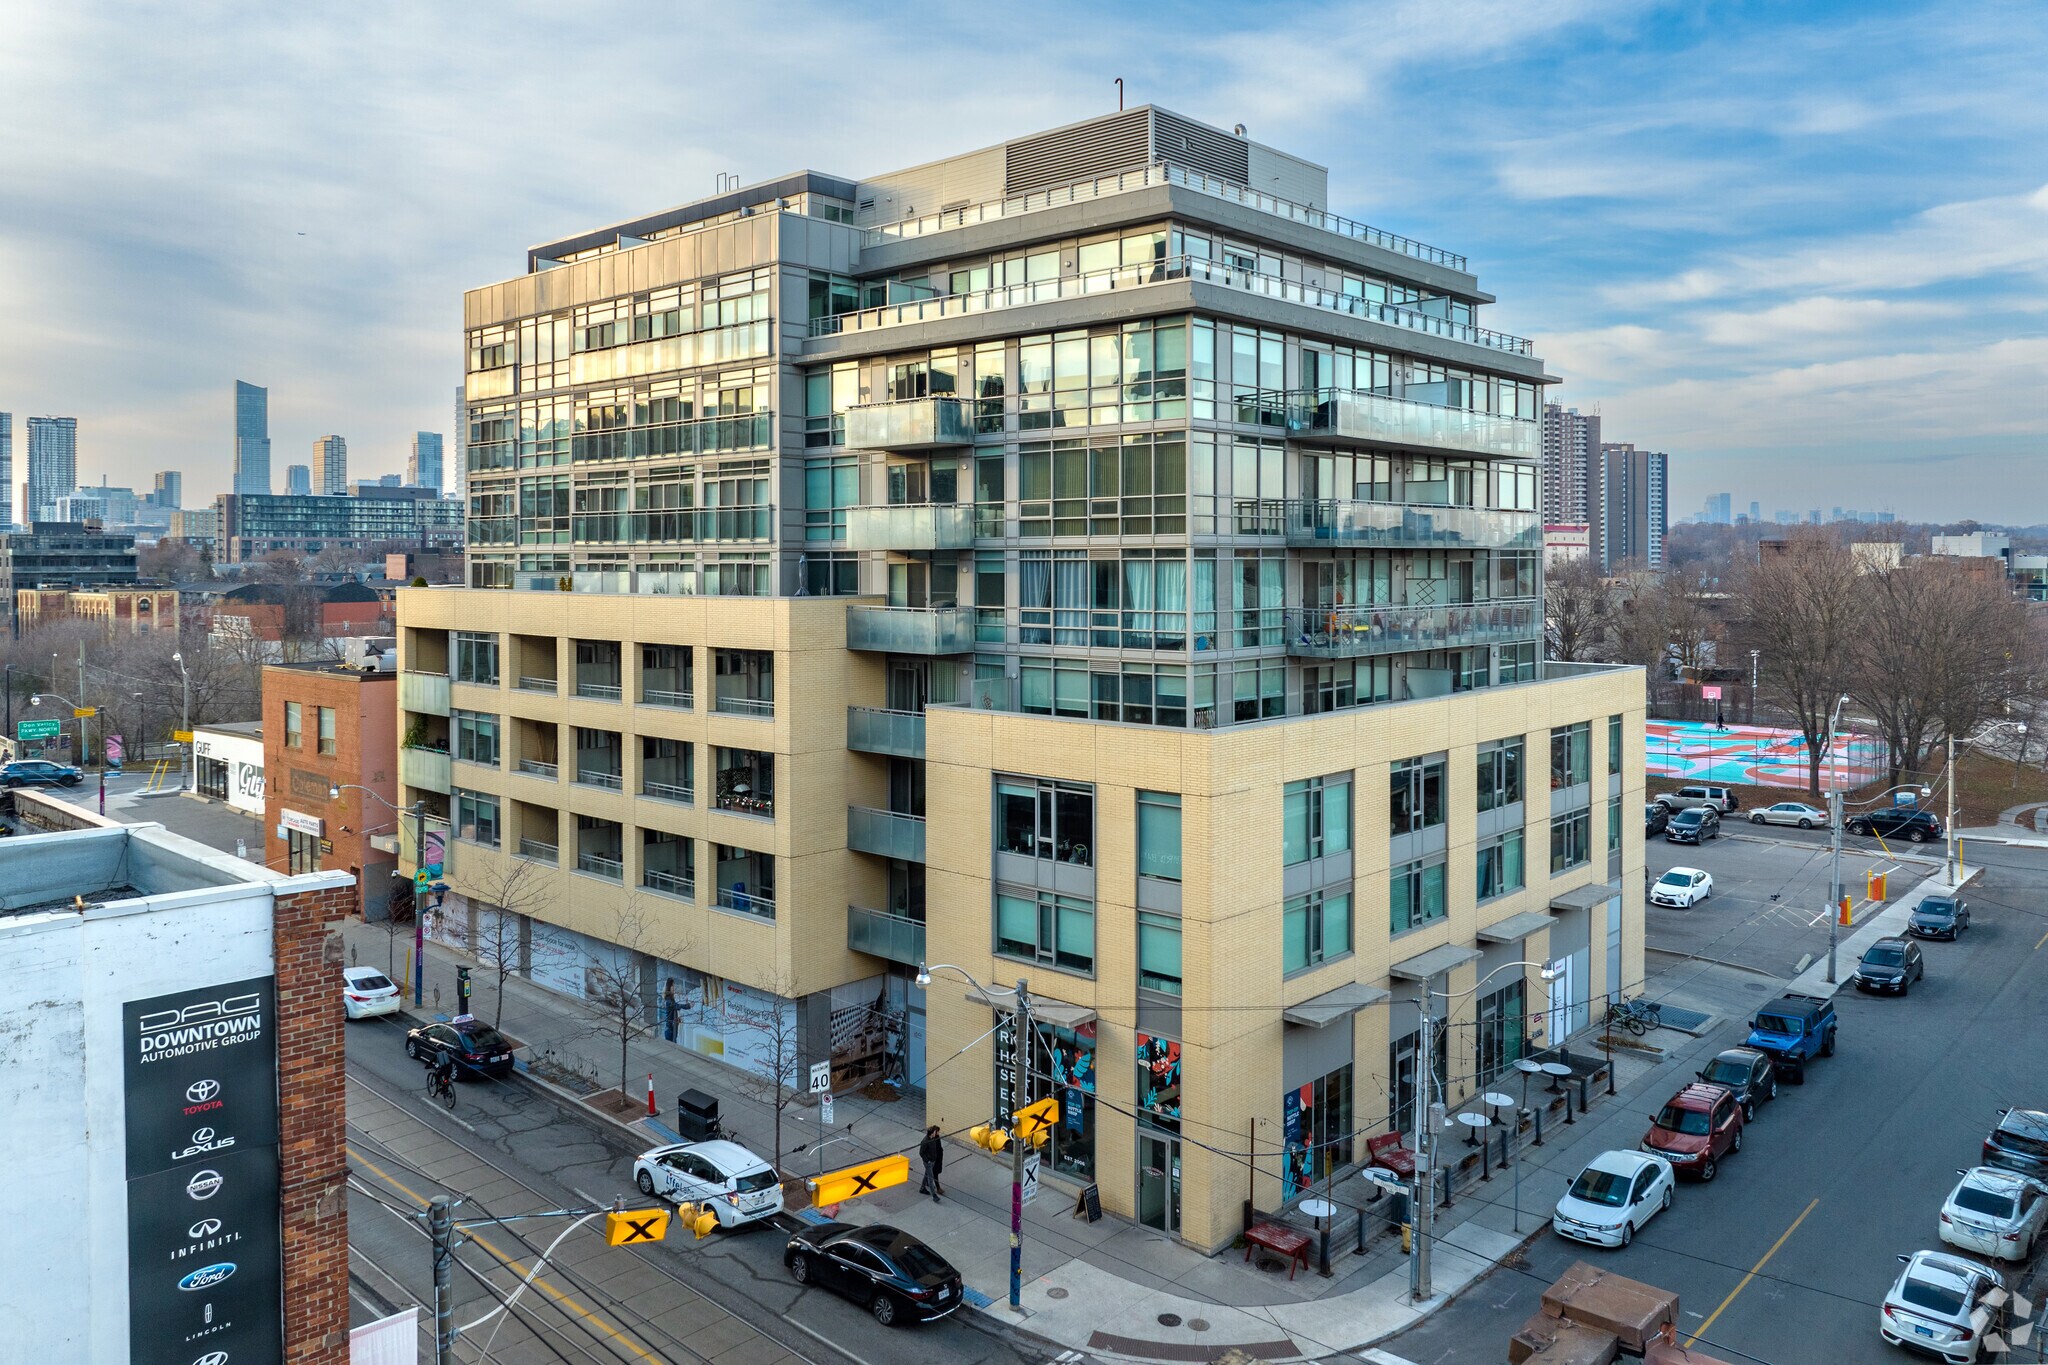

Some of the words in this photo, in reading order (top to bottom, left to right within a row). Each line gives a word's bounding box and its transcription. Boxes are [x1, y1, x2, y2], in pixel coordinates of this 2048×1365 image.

[195, 741, 211, 755] GUFF
[140, 993, 260, 1032] DAG
[141, 1014, 260, 1053] DOWNTOWN
[141, 1039, 219, 1064] AUTOMOTIVE
[221, 1030, 260, 1047] GROUP
[812, 1073, 829, 1090] 40
[183, 1100, 223, 1116] TOYOTA
[172, 1136, 235, 1160] LEXUS
[190, 1178, 220, 1191] NISSAN
[171, 1232, 239, 1260] INFINITI
[190, 1268, 225, 1288] Ford
[186, 1322, 232, 1342] LINCOLN
